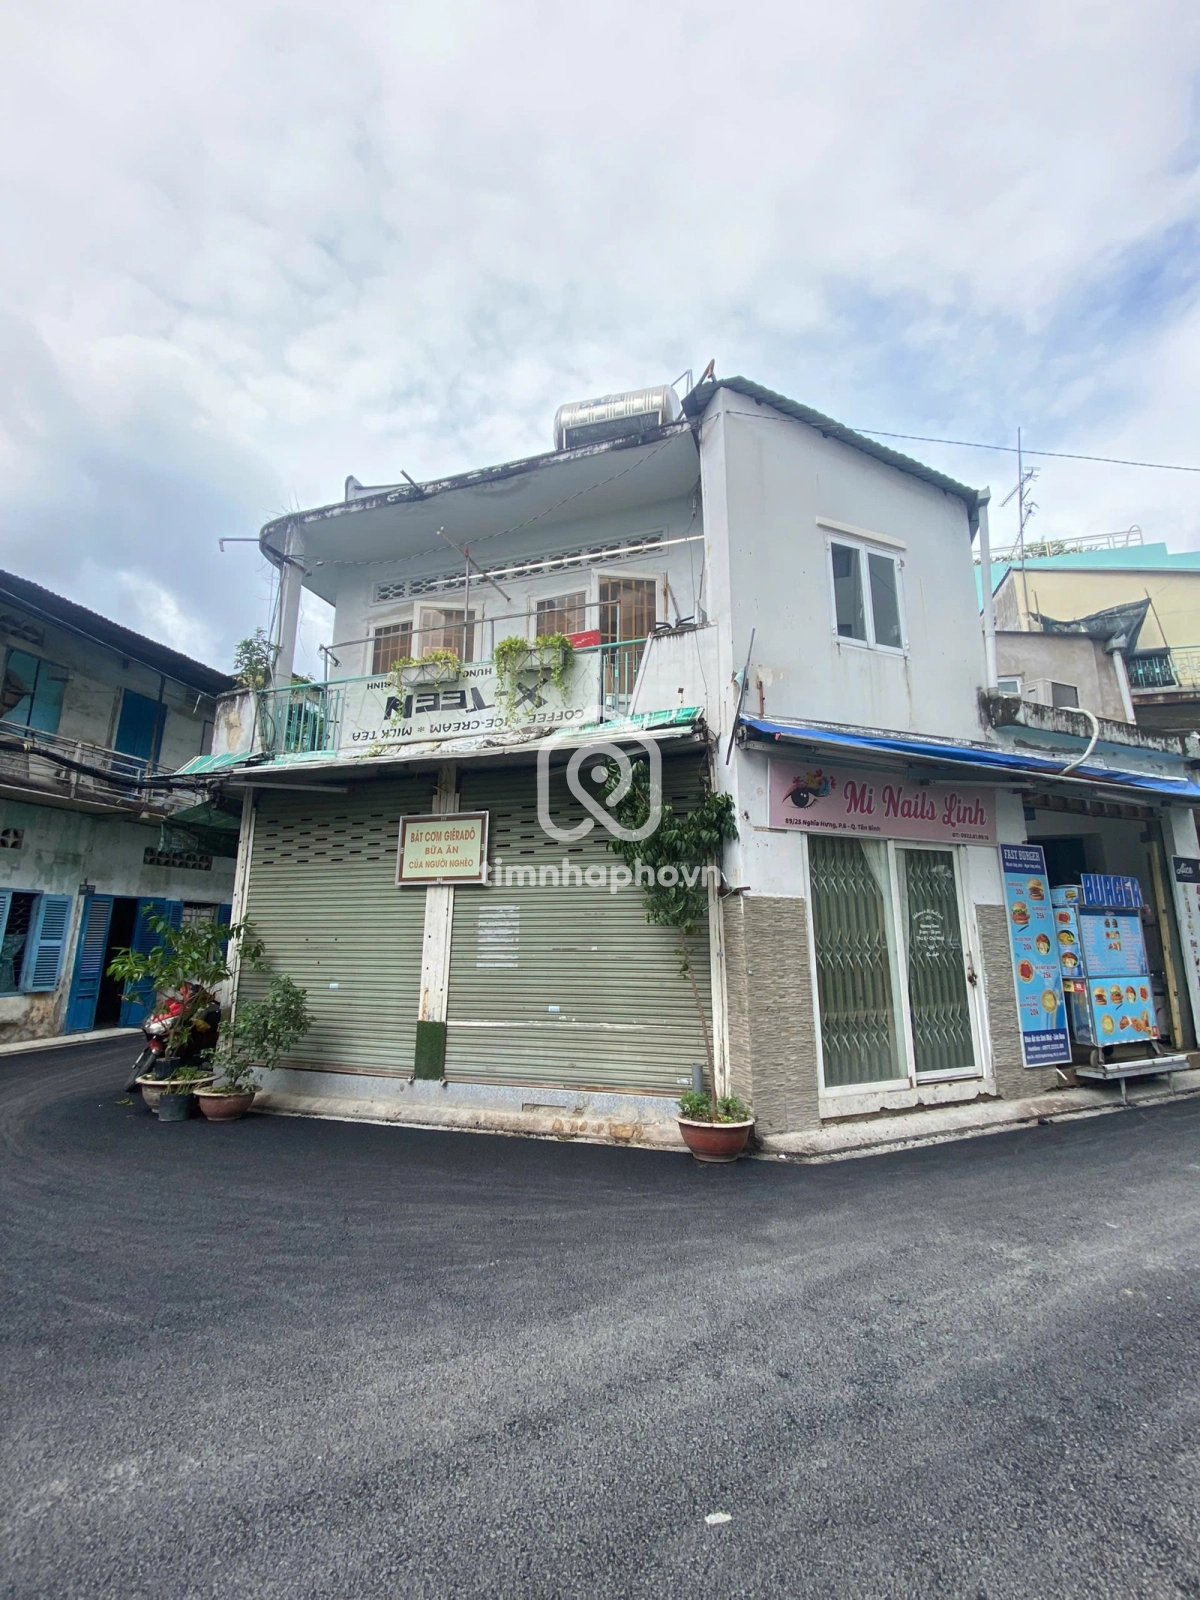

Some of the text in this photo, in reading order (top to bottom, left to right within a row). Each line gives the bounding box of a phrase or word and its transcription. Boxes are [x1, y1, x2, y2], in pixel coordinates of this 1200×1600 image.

[527, 709, 584, 724] COFFEE
[352, 730, 377, 741] TEA
[381, 726, 412, 738] MILK
[843, 780, 987, 827] Mi Nails Linh
[784, 817, 802, 825] 89/25
[802, 818, 820, 827] Nghĩa
[410, 829, 423, 842] BÁT
[425, 829, 442, 842] CƠM
[425, 844, 459, 855] BỮA ĂN
[1003, 848, 1041, 862] FAST BURGER
[408, 856, 474, 869] CỦA NGƯỜI NGHÈO
[1081, 874, 1142, 907] BURGER
